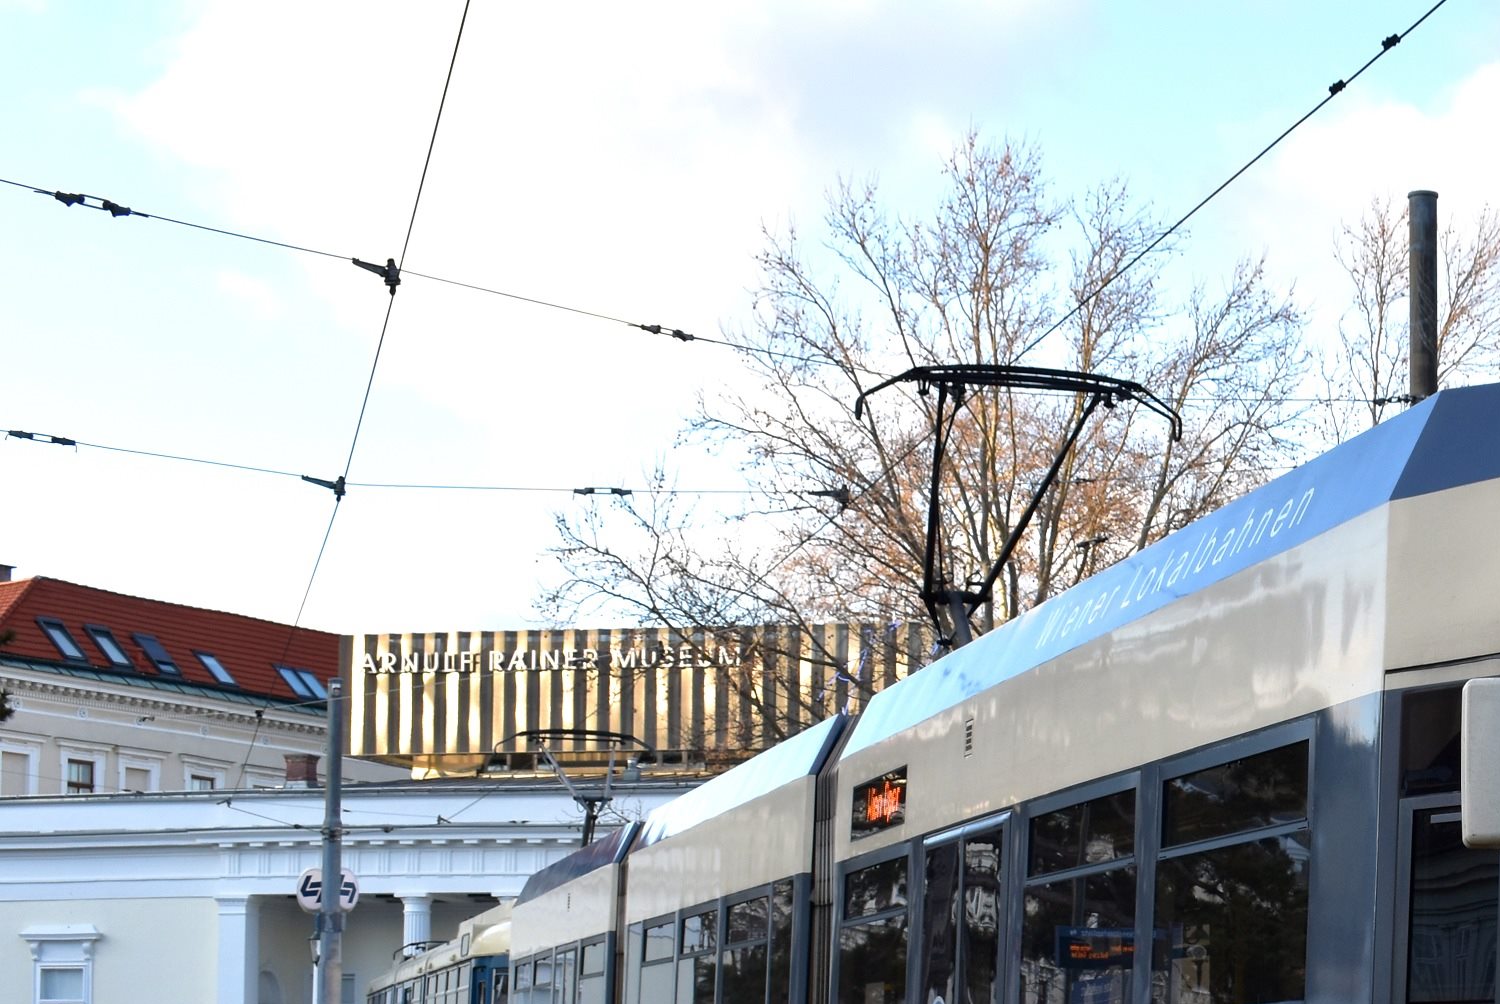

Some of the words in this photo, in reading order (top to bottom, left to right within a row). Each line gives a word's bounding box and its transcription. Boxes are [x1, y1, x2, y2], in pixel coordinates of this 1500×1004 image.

[1034, 583, 1121, 650] Wiener
[1120, 485, 1316, 610] Lokalbahnen
[362, 650, 474, 674] ARNULF
[488, 648, 599, 672] RAINER
[610, 645, 742, 669] MUSEUM
